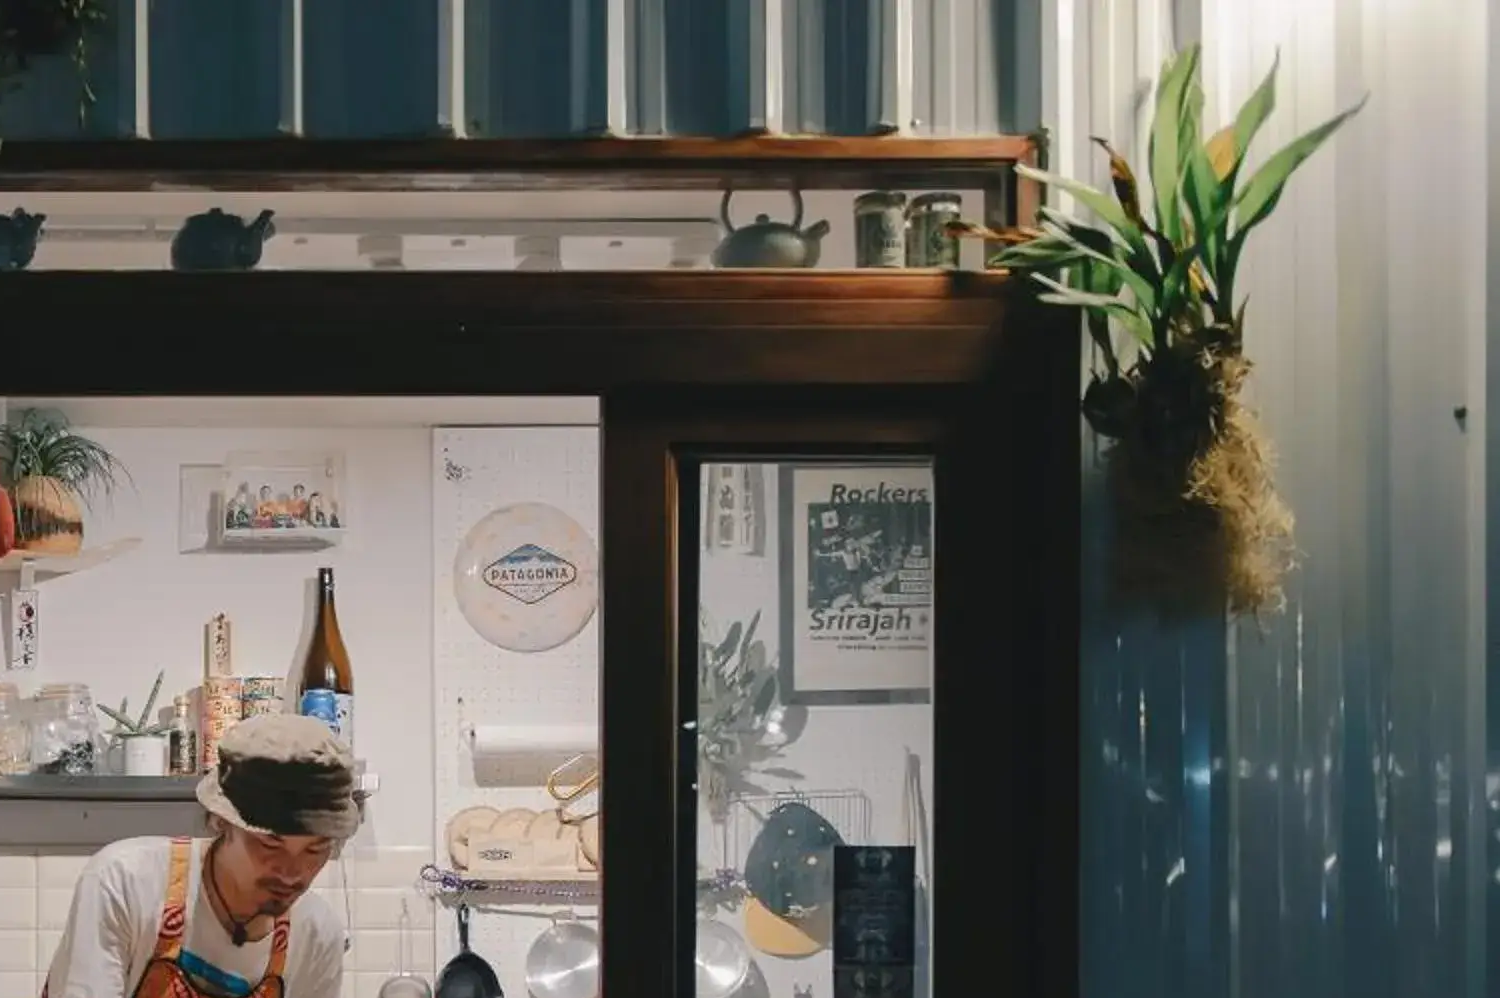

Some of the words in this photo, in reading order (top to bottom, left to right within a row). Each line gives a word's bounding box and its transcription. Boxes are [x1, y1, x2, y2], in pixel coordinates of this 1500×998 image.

[830, 482, 928, 504] Rockers
[491, 567, 568, 581] PATAGONIA
[809, 606, 912, 636] Srirajah
